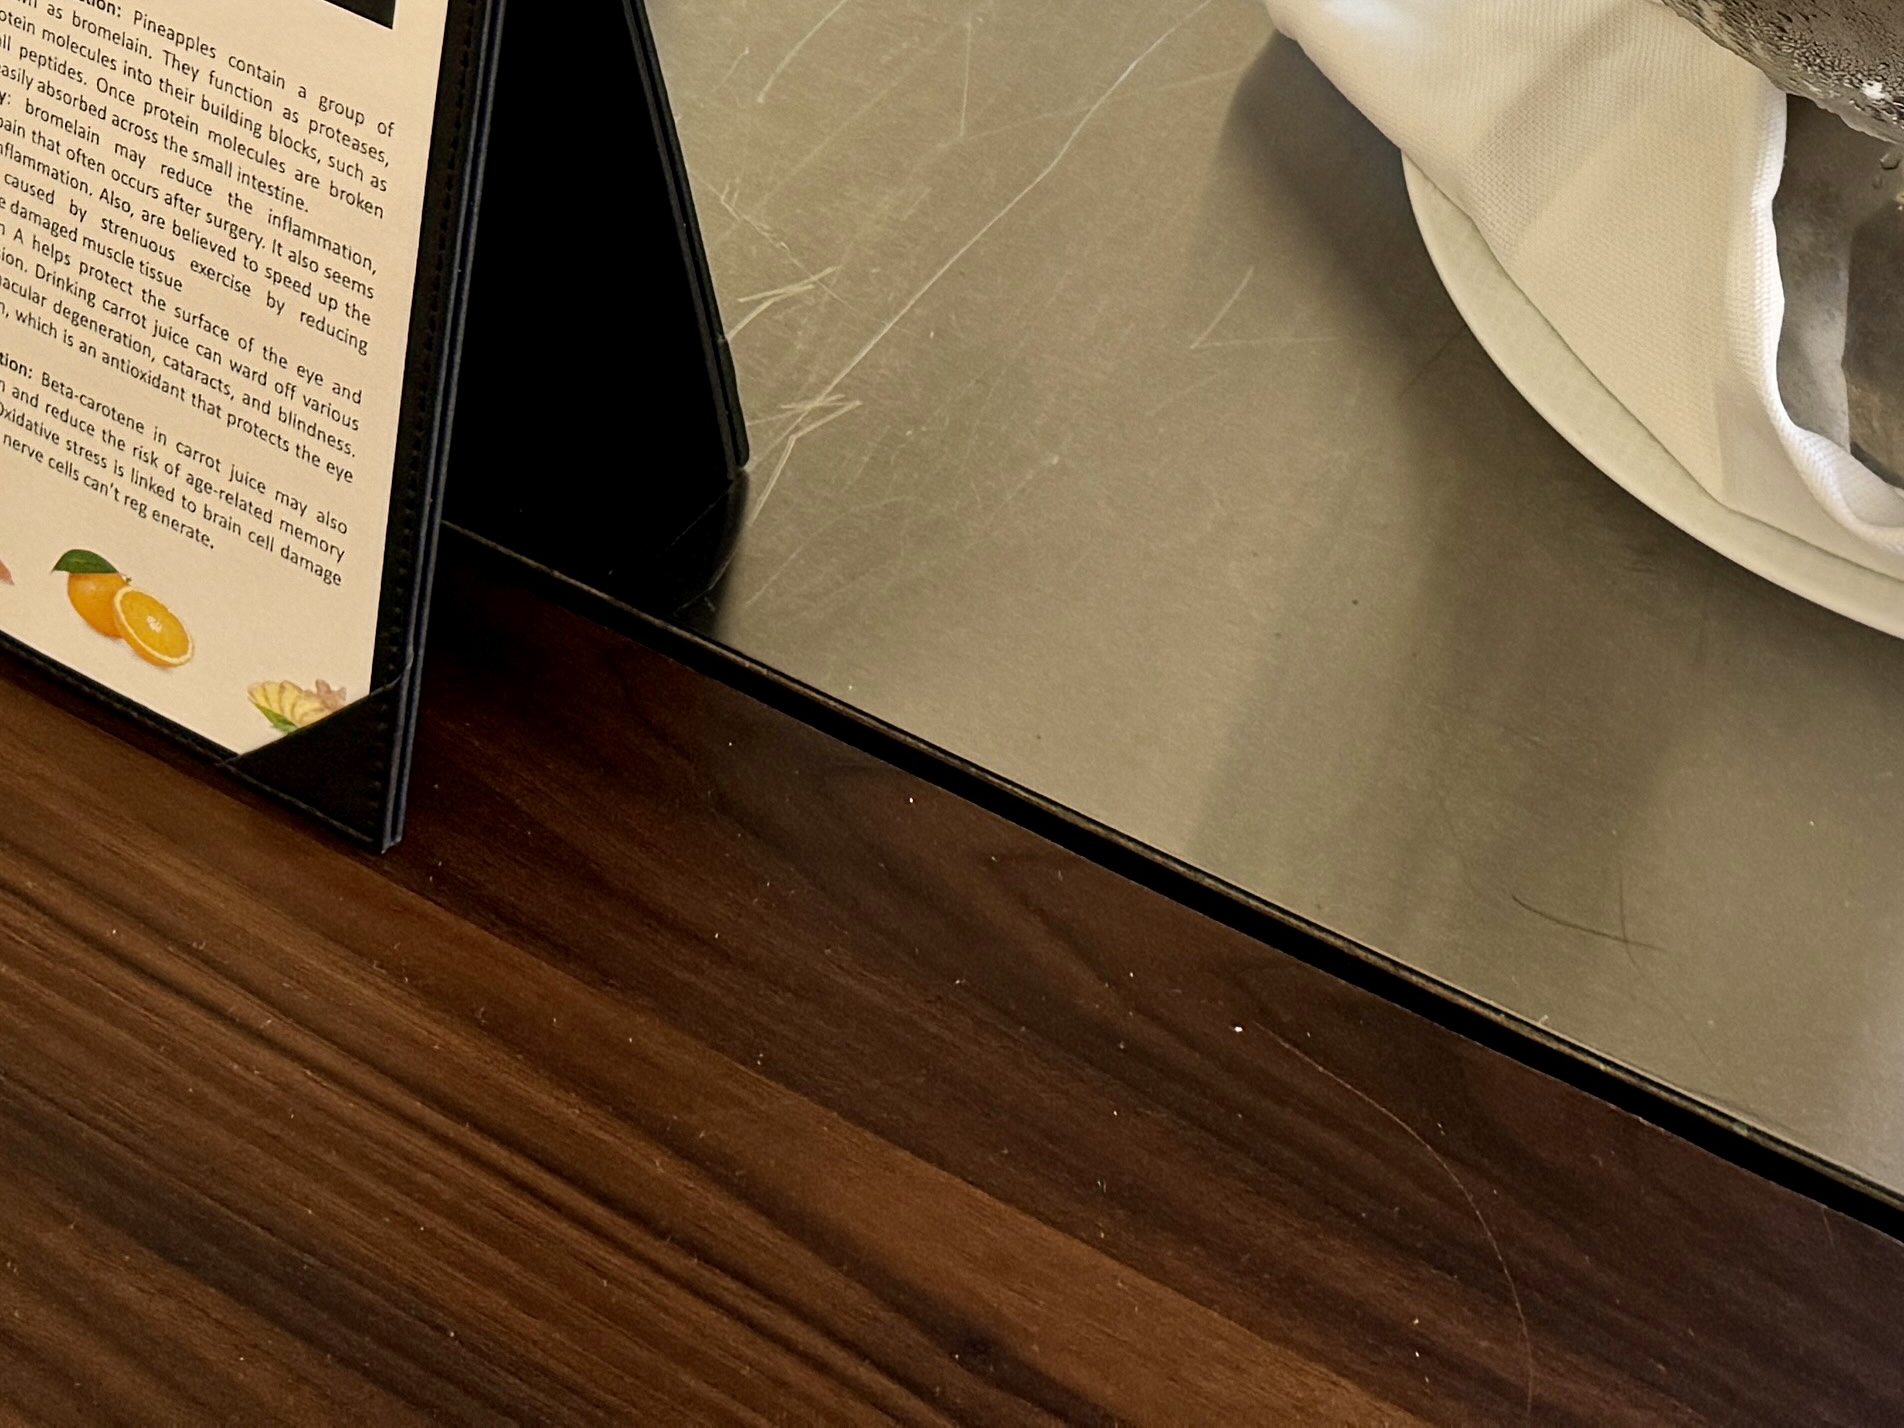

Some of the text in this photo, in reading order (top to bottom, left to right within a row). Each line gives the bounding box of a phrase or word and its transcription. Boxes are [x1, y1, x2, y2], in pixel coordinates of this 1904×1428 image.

[17, 44, 88, 86] peptides.
[95, 75, 136, 107] Once
[141, 99, 199, 136] protein
[206, 128, 287, 174] molecules
[292, 167, 321, 190] are
[328, 178, 384, 220] broken
[35, 78, 108, 121] absorbed
[110, 112, 159, 145] across
[162, 133, 189, 159] the
[189, 149, 233, 179] small
[235, 164, 309, 214] intestine.
[40, 26, 118, 72] molecules
[121, 58, 153, 86] into
[157, 76, 196, 105] their
[199, 92, 264, 140] building
[267, 122, 322, 166] blocks,
[325, 154, 364, 183] such
[368, 173, 388, 193] as
[45, 2, 64, 20] as
[70, 8, 153, 60] bromelain.
[160, 47, 200, 83] They
[207, 68, 273, 113] function
[281, 105, 300, 124] as
[307, 117, 389, 169] proteases,
[131, 8, 217, 60] Pineapples
[226, 54, 286, 90] contain
[296, 84, 307, 100] a
[316, 94, 366, 128] group
[375, 120, 396, 138] of
[2, 172, 56, 206] caused
[67, 196, 88, 224] by
[99, 216, 176, 262] strenuous
[188, 258, 252, 298] exercise
[264, 288, 286, 317] by
[298, 310, 369, 357] reducing
[8, 198, 79, 243] damaged
[80, 234, 135, 270] muscle
[137, 258, 183, 293] tissue
[23, 95, 100, 146] bromelain
[113, 141, 147, 170] may
[159, 162, 213, 197] reduce
[226, 190, 253, 216] the
[266, 206, 377, 277] inflammation,
[30, 128, 63, 156] that
[64, 146, 106, 175] often
[109, 167, 161, 200] occurs
[162, 191, 203, 219] after
[203, 210, 266, 252] surgery.
[270, 236, 284, 258] It
[286, 248, 320, 274] also
[322, 265, 375, 300] seems
[97, 186, 135, 219] Also,
[139, 207, 166, 230] are
[170, 217, 237, 263] believed
[241, 252, 259, 273] to
[262, 265, 313, 299] speed
[316, 290, 339, 313] up
[343, 300, 372, 327] the
[11, 226, 24, 246] A
[30, 231, 72, 267] helps
[77, 259, 135, 297] protect
[140, 286, 167, 312] the
[172, 305, 230, 342] surface
[236, 335, 256, 353] of
[261, 344, 289, 370] the
[295, 363, 324, 387] eye
[330, 380, 363, 406] and
[51, 298, 156, 364] degeneration,
[161, 353, 235, 402] cataracts,
[240, 391, 272, 417] and
[276, 403, 356, 458] blindness.
[39, 369, 145, 436] Beta-carotene
[151, 424, 168, 447] in
[174, 440, 222, 474] carrot
[226, 462, 267, 495] juice
[273, 488, 308, 519] may
[314, 509, 348, 535] also
[64, 438, 108, 470] stress
[111, 457, 125, 478] is
[129, 465, 176, 503] linked
[180, 493, 197, 514] to
[201, 501, 242, 537] brain
[246, 529, 275, 553] cell
[279, 542, 342, 587] damage
